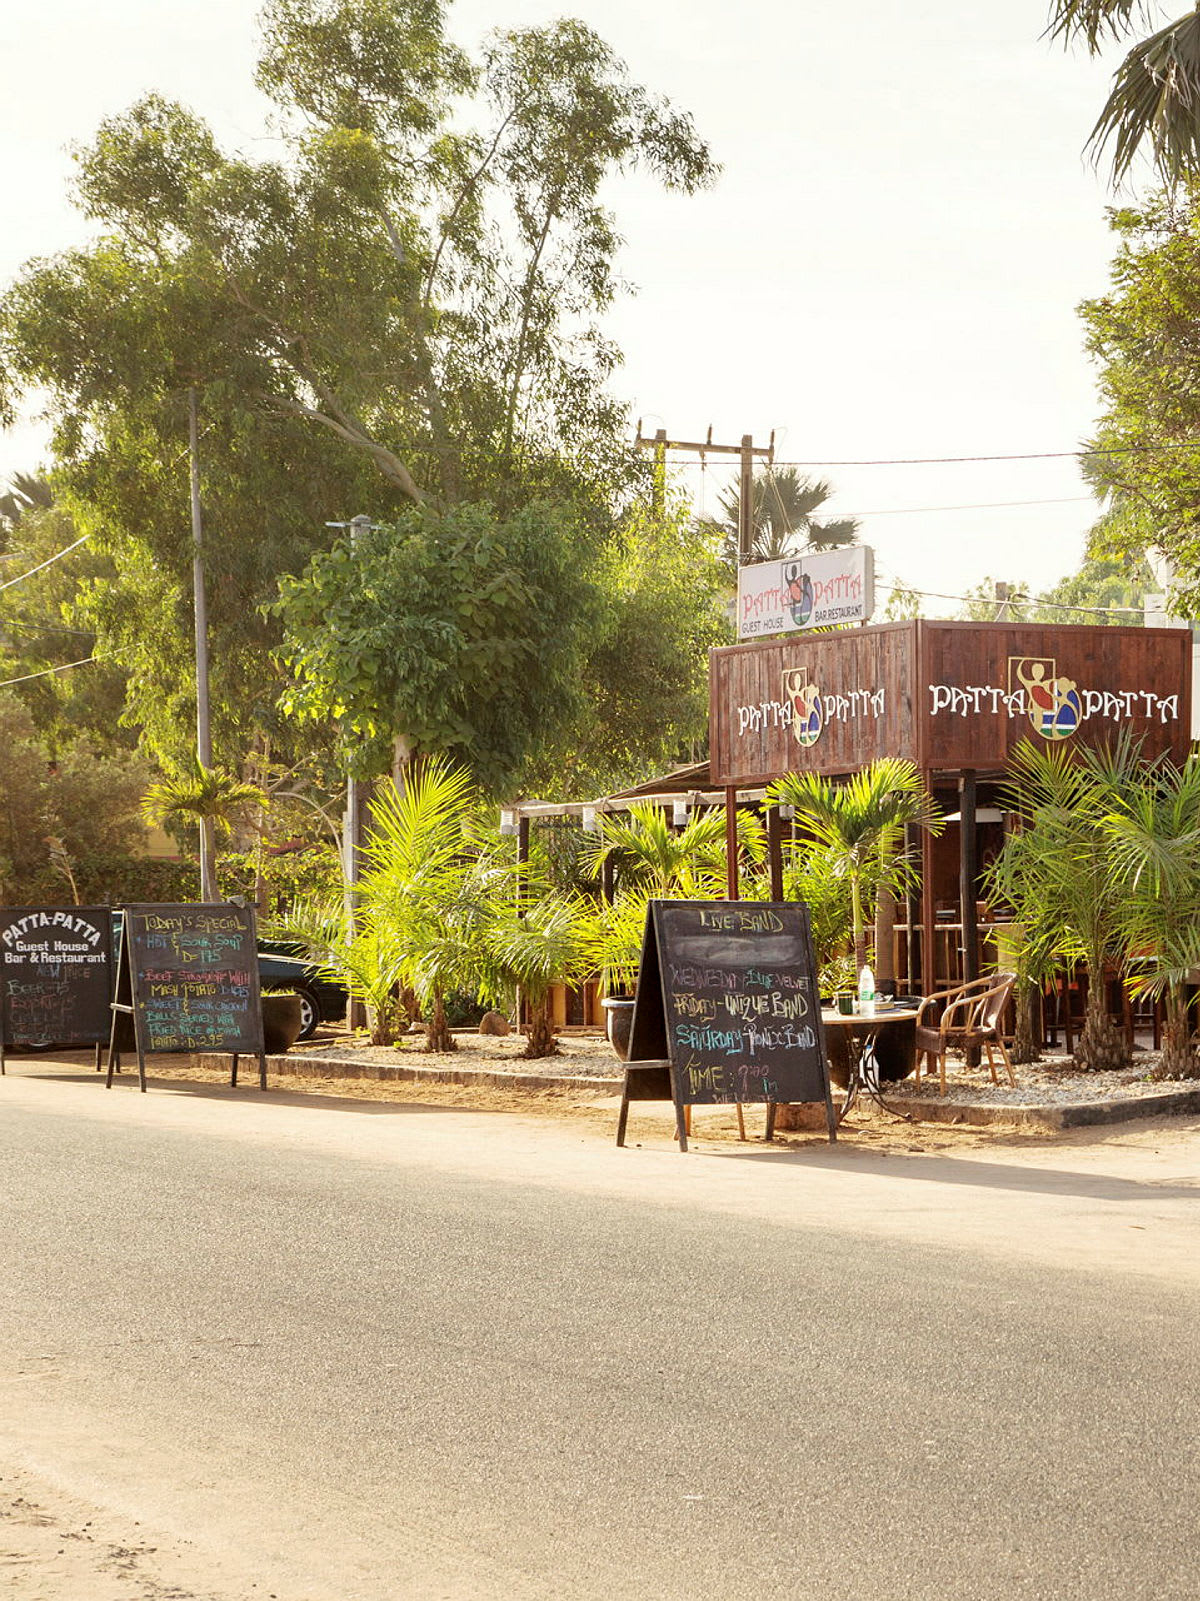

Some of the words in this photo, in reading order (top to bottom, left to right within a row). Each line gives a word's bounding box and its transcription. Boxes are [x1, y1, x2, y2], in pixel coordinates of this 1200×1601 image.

[743, 587, 792, 619] PATTA
[814, 573, 862, 606] PATTA
[742, 620, 761, 634] GUEST
[763, 617, 784, 630] HOUSE
[738, 699, 793, 736] PATTA
[824, 688, 885, 725] PATTA
[929, 684, 1027, 718] PATTA
[1082, 689, 1179, 724] PATTA
[700, 911, 732, 932] LIVE
[740, 911, 783, 932] BAND
[4, 952, 27, 963] Bar
[30, 952, 39, 963] &
[40, 951, 106, 963] Restaurant
[15, 940, 50, 952] Guest
[54, 940, 89, 951] House
[771, 991, 808, 1020] BAND
[676, 1024, 743, 1055] SATURDAY
